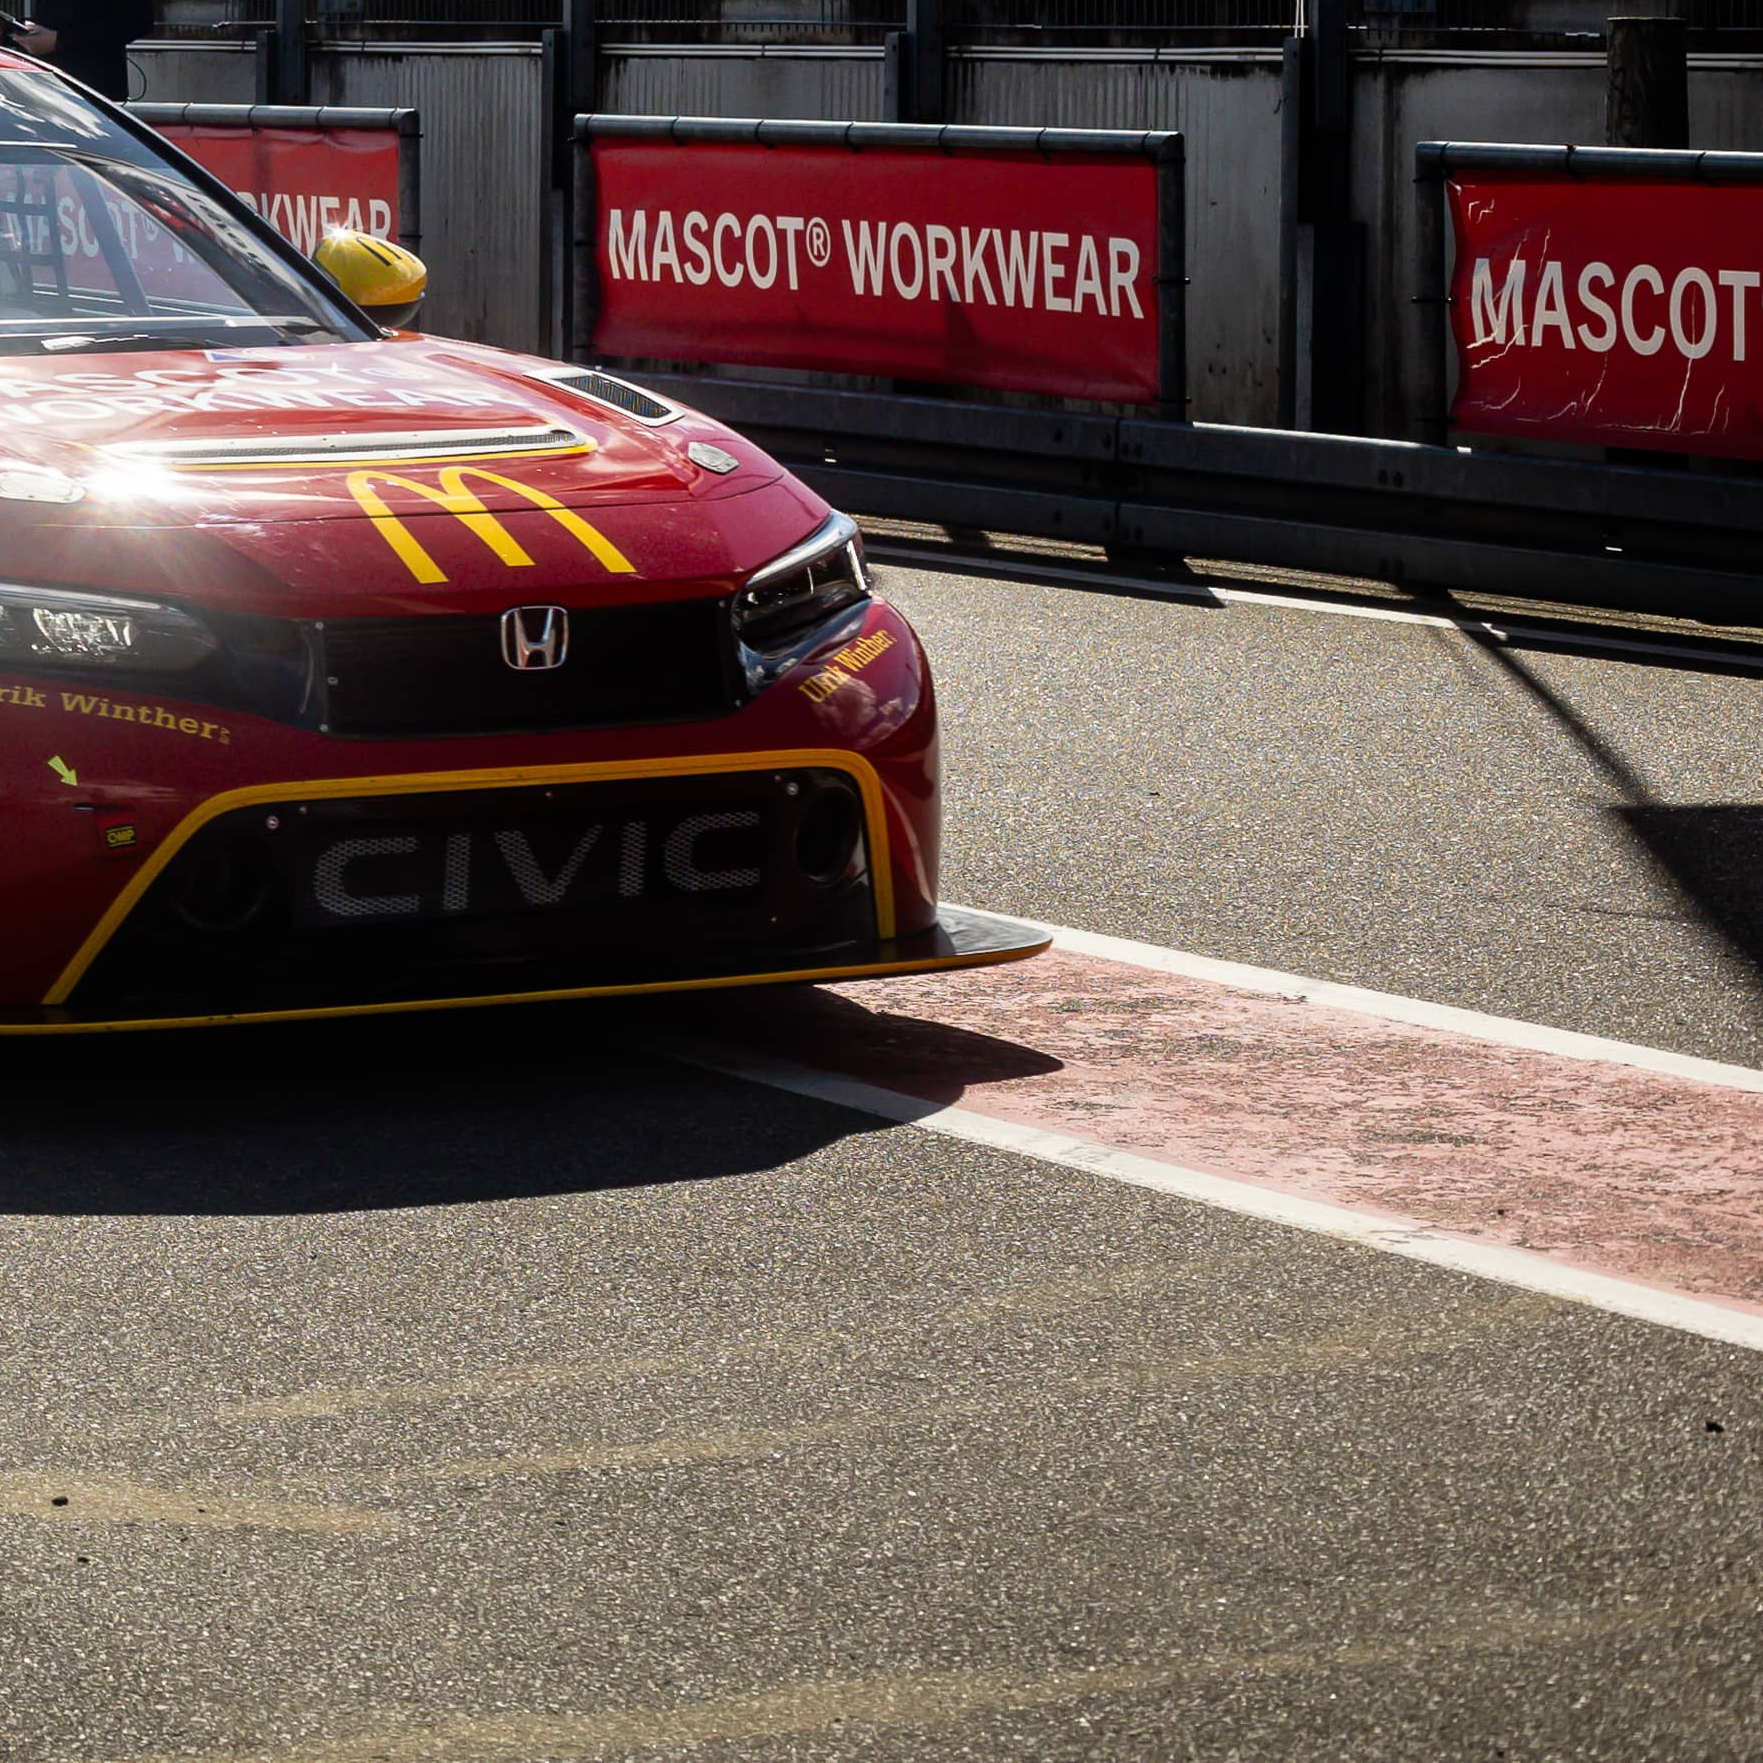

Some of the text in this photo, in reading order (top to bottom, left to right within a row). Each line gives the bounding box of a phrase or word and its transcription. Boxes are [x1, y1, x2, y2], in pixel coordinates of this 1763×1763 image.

[841, 218, 1145, 320] WORKWEAR
[1470, 257, 1761, 362] MASCOT
[60, 691, 219, 740] Winther
[313, 811, 762, 918] CIVIC
